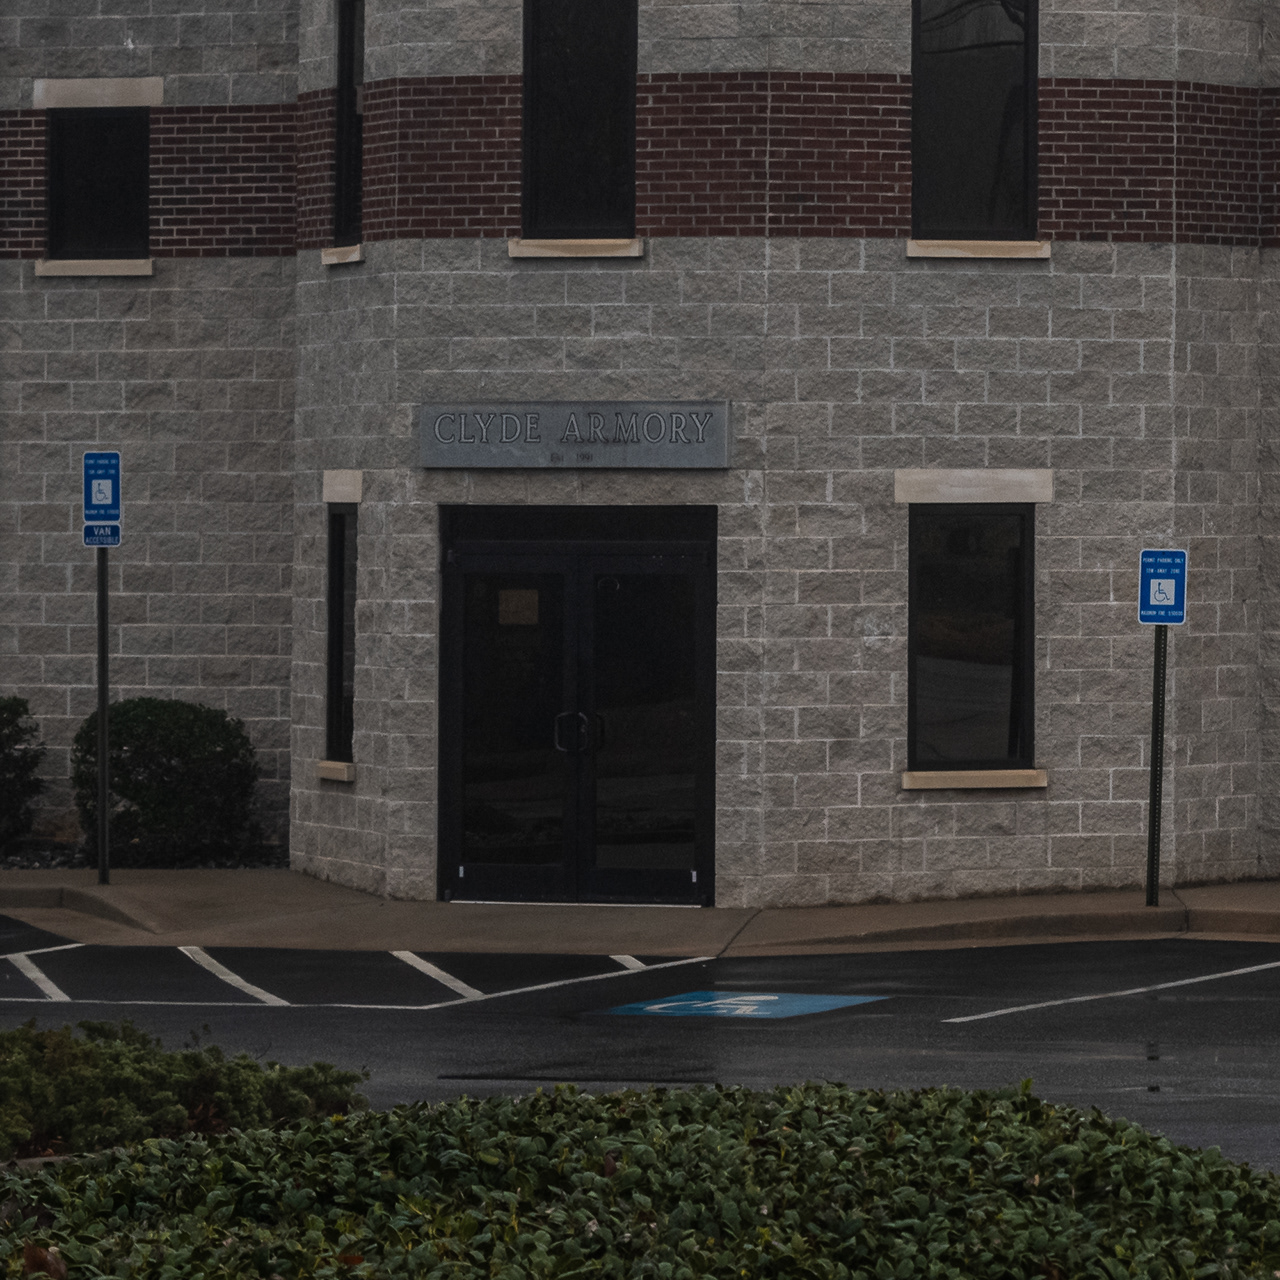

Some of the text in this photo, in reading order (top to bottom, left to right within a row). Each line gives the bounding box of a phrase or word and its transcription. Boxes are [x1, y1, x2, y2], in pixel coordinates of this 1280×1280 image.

[434, 412, 713, 445] CLYDE ARMORY
[94, 527, 111, 535] VAN
